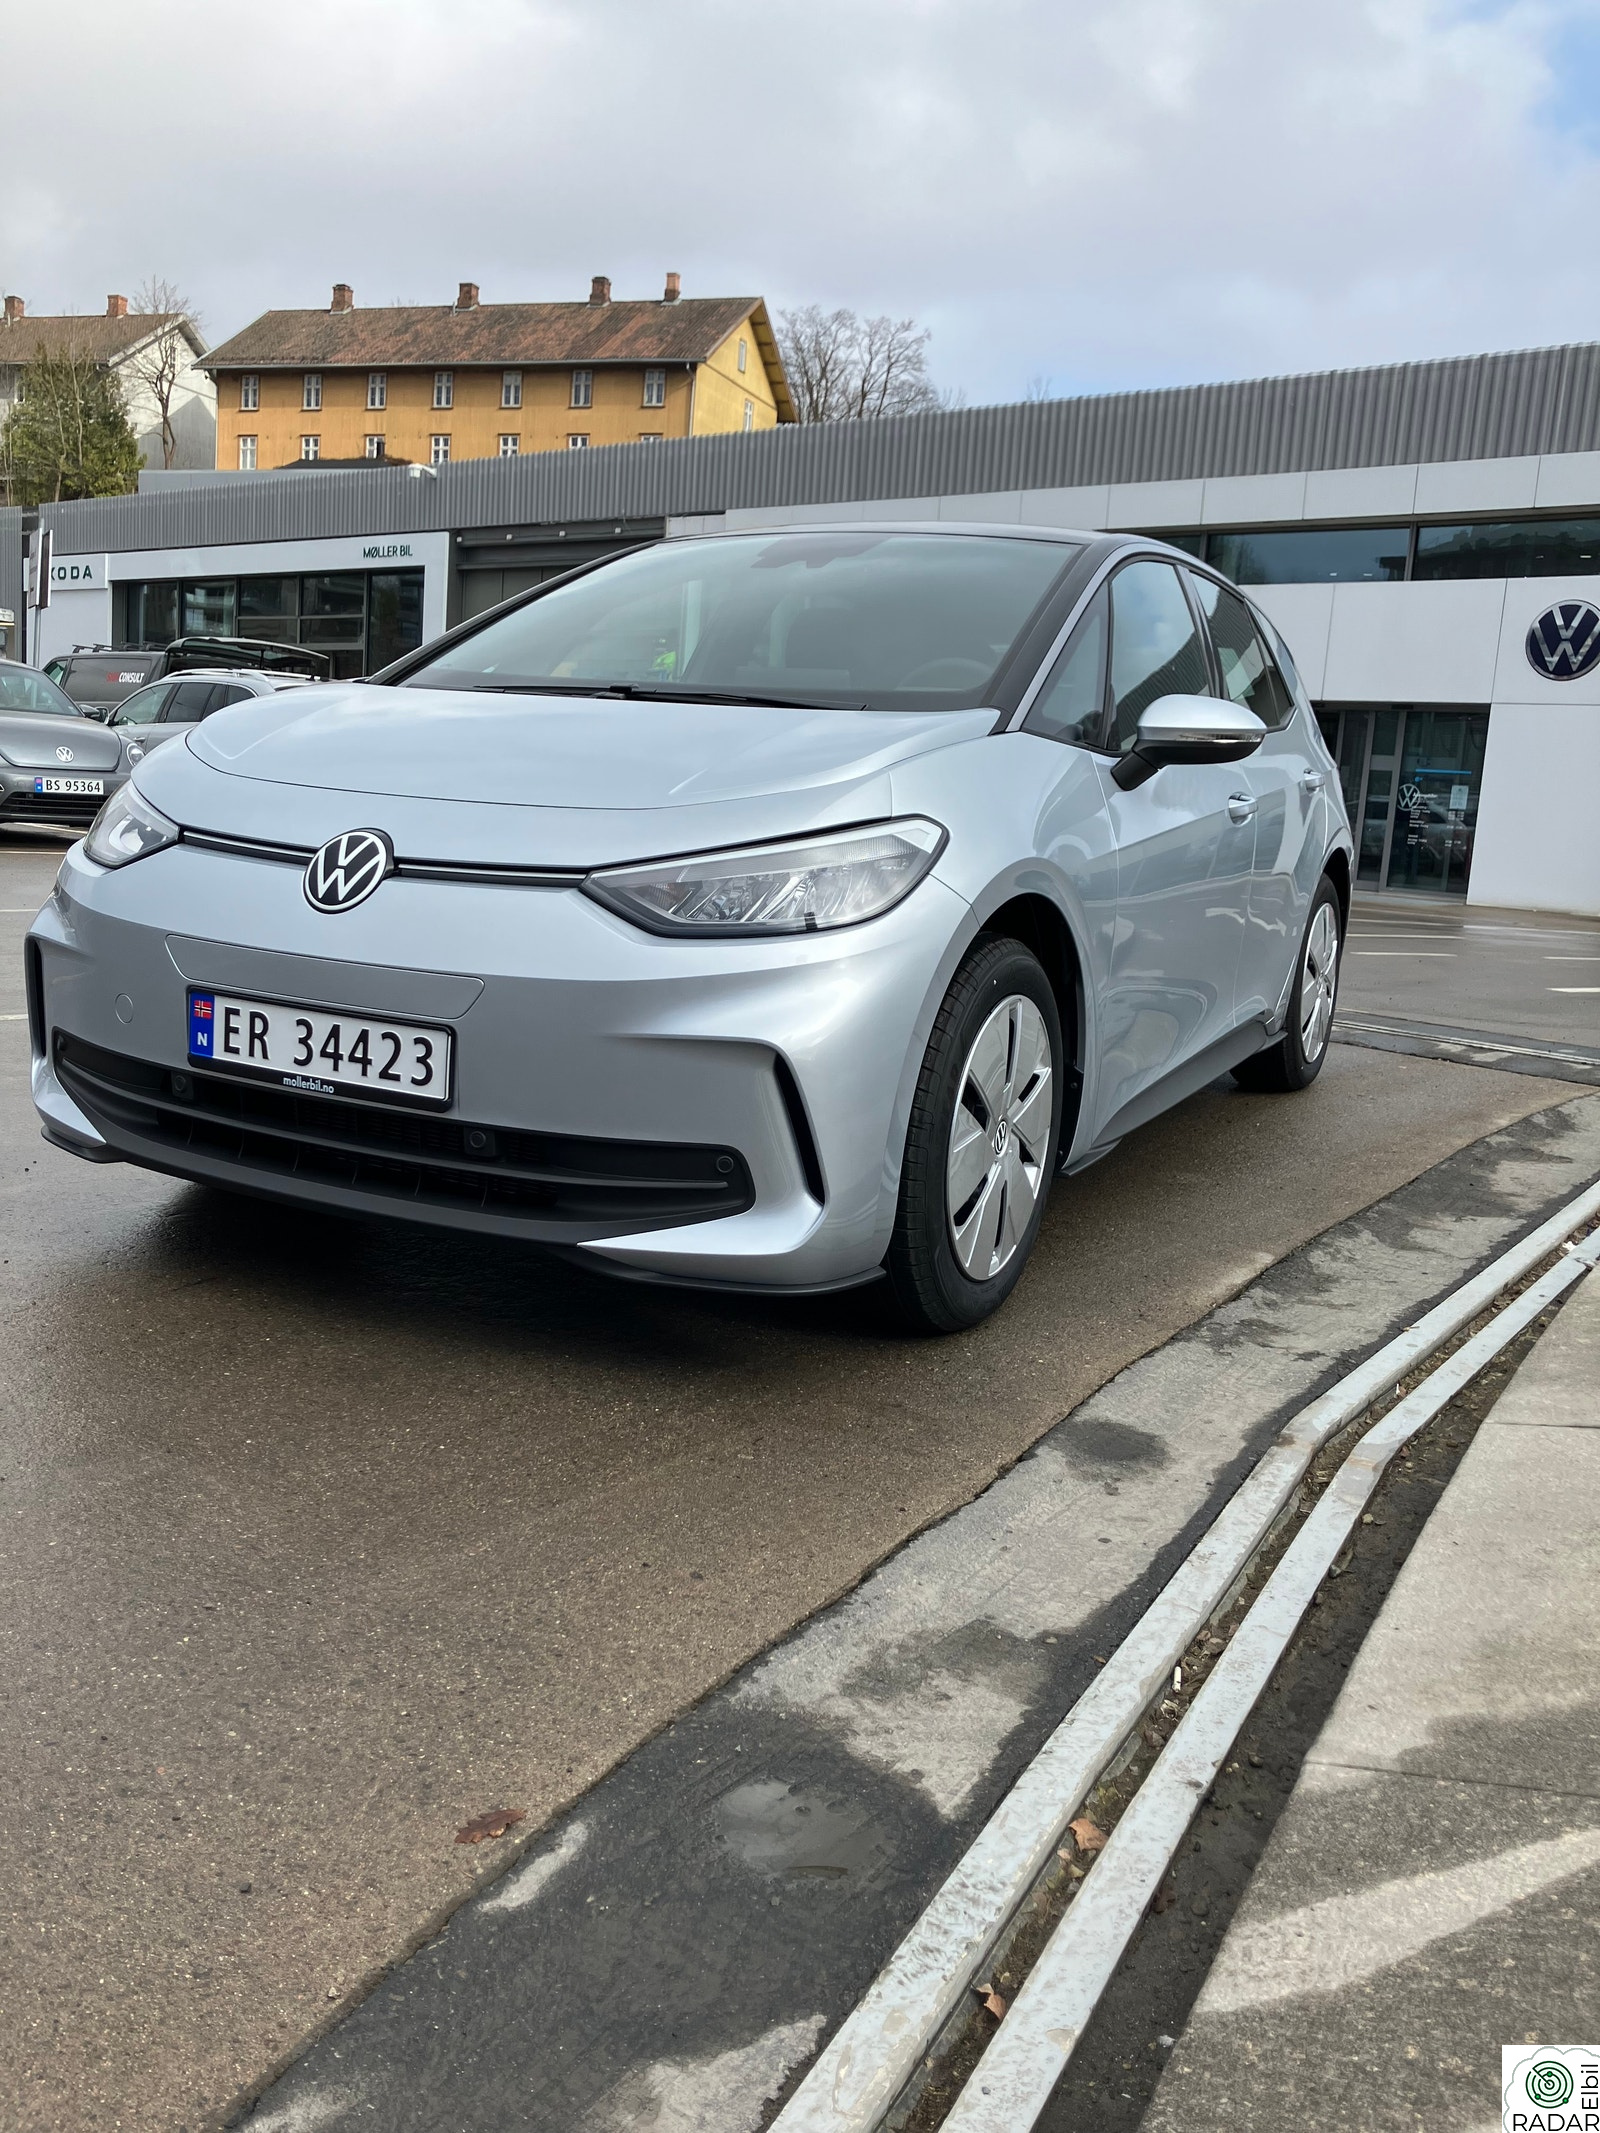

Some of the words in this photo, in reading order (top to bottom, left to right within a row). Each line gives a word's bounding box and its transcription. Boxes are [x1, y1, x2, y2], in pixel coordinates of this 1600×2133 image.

[363, 545, 398, 558] MØLLER
[400, 544, 413, 557] BIL
[46, 780, 60, 791] BS
[65, 781, 101, 793] 95364
[197, 1032, 208, 1047] N
[224, 1006, 270, 1060] ER
[293, 1018, 435, 1087] 34423
[283, 1076, 335, 1094] mollerbil.no
